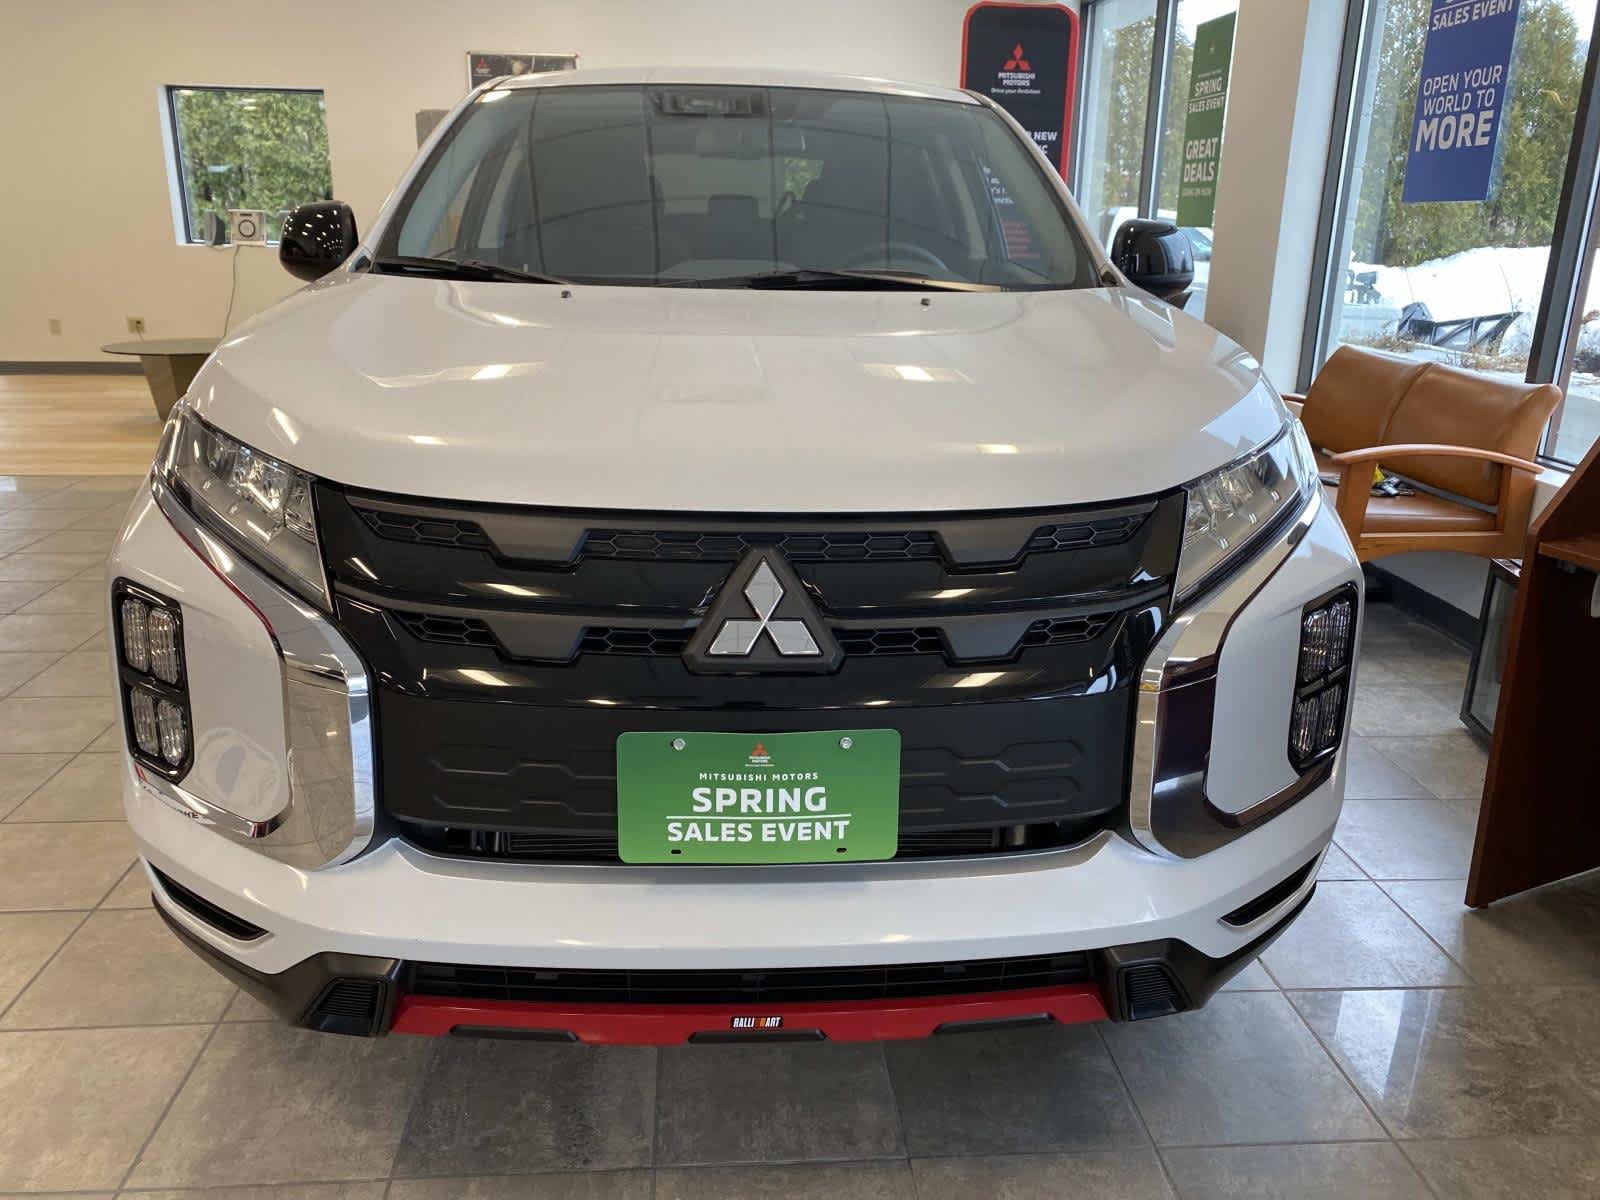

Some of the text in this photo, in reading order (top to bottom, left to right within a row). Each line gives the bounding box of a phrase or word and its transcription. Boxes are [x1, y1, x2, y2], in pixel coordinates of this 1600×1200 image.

[1432, 0, 1513, 31] SALES EVENT
[1194, 77, 1222, 96] SPRING
[1423, 65, 1502, 95] OPEN YOUR
[1424, 88, 1495, 116] WORLD TO
[1033, 131, 1058, 141] NEW
[1415, 110, 1495, 152] MORE
[1185, 137, 1218, 160] GREAT
[1183, 161, 1215, 182] DEALS
[699, 772, 819, 782] MITSUBISHI MOTORS
[691, 786, 827, 813] SPRING
[667, 820, 850, 842] SALES EVENT
